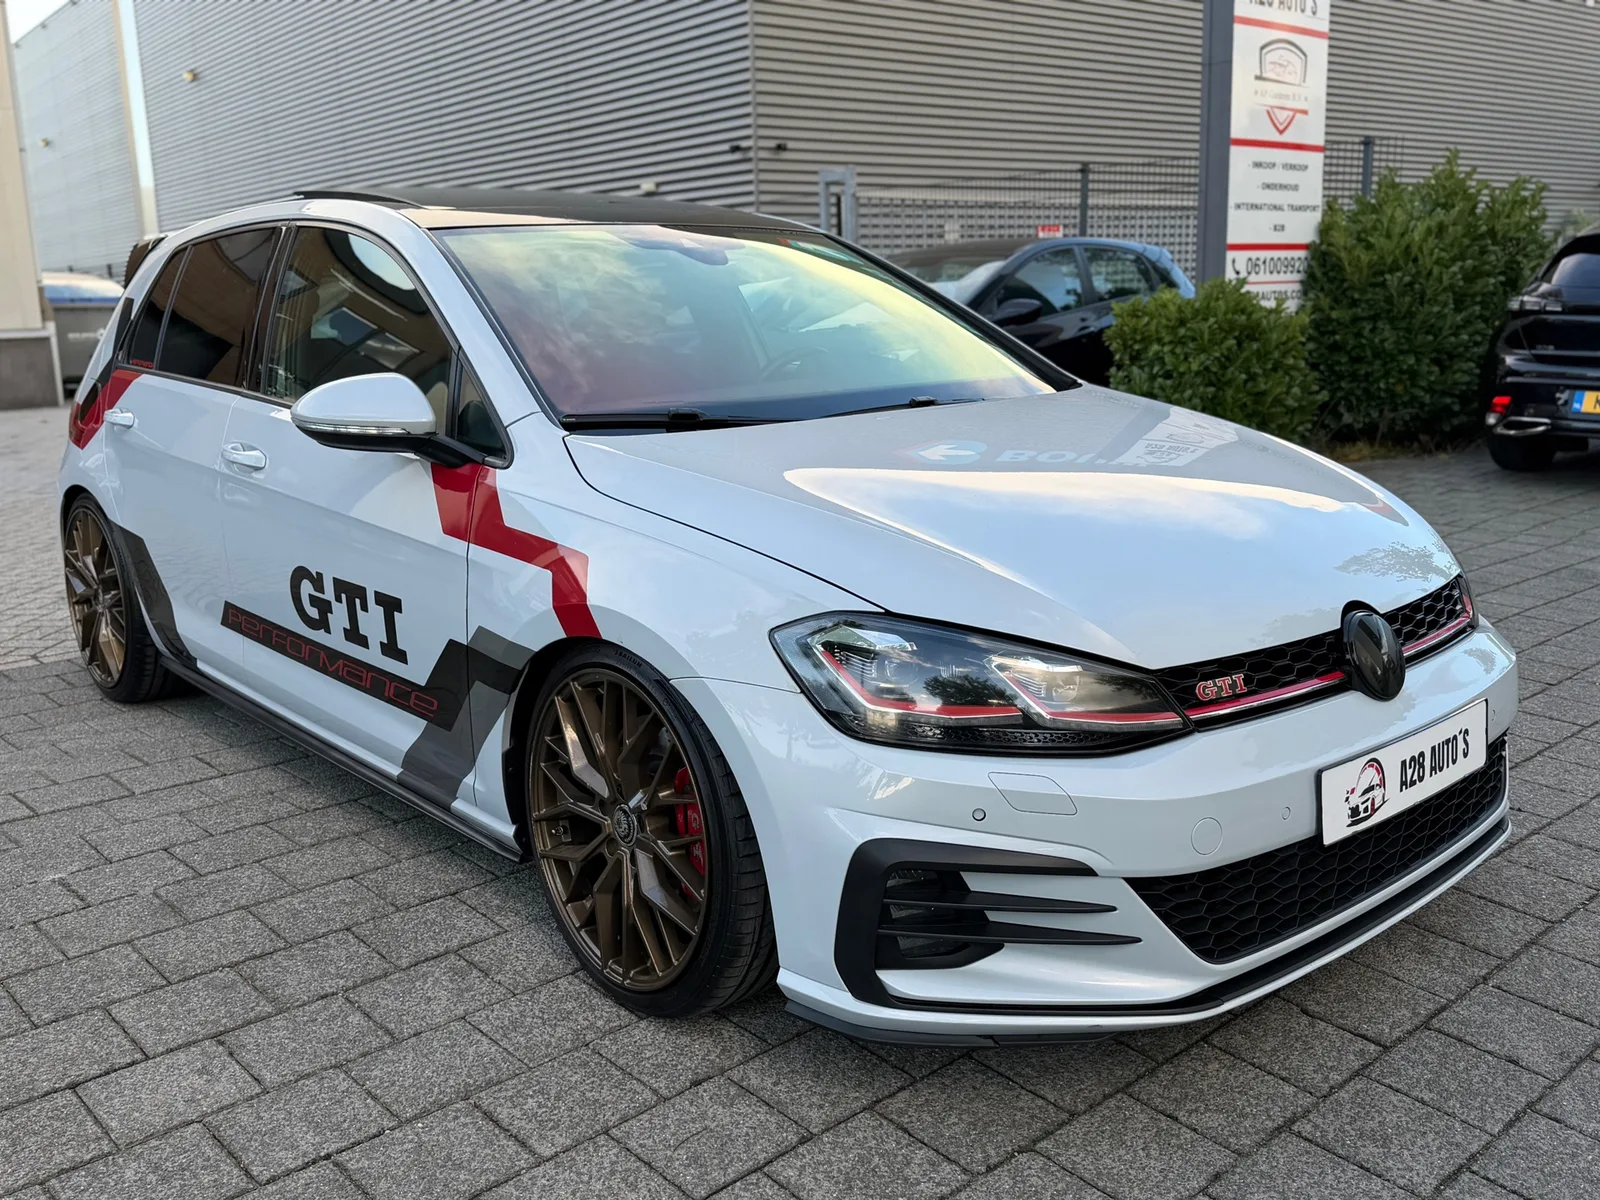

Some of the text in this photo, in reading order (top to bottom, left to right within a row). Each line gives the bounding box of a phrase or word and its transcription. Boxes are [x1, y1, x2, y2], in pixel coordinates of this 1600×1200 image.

[1251, 161, 1309, 171] INKOOP VERKOOP
[1261, 182, 1300, 192] ONDERHOUD
[1234, 202, 1320, 212] INTERNATIONAL TRANSPORT
[290, 566, 408, 665] GTI
[1196, 674, 1247, 700] GTI
[1400, 751, 1426, 793] A28
